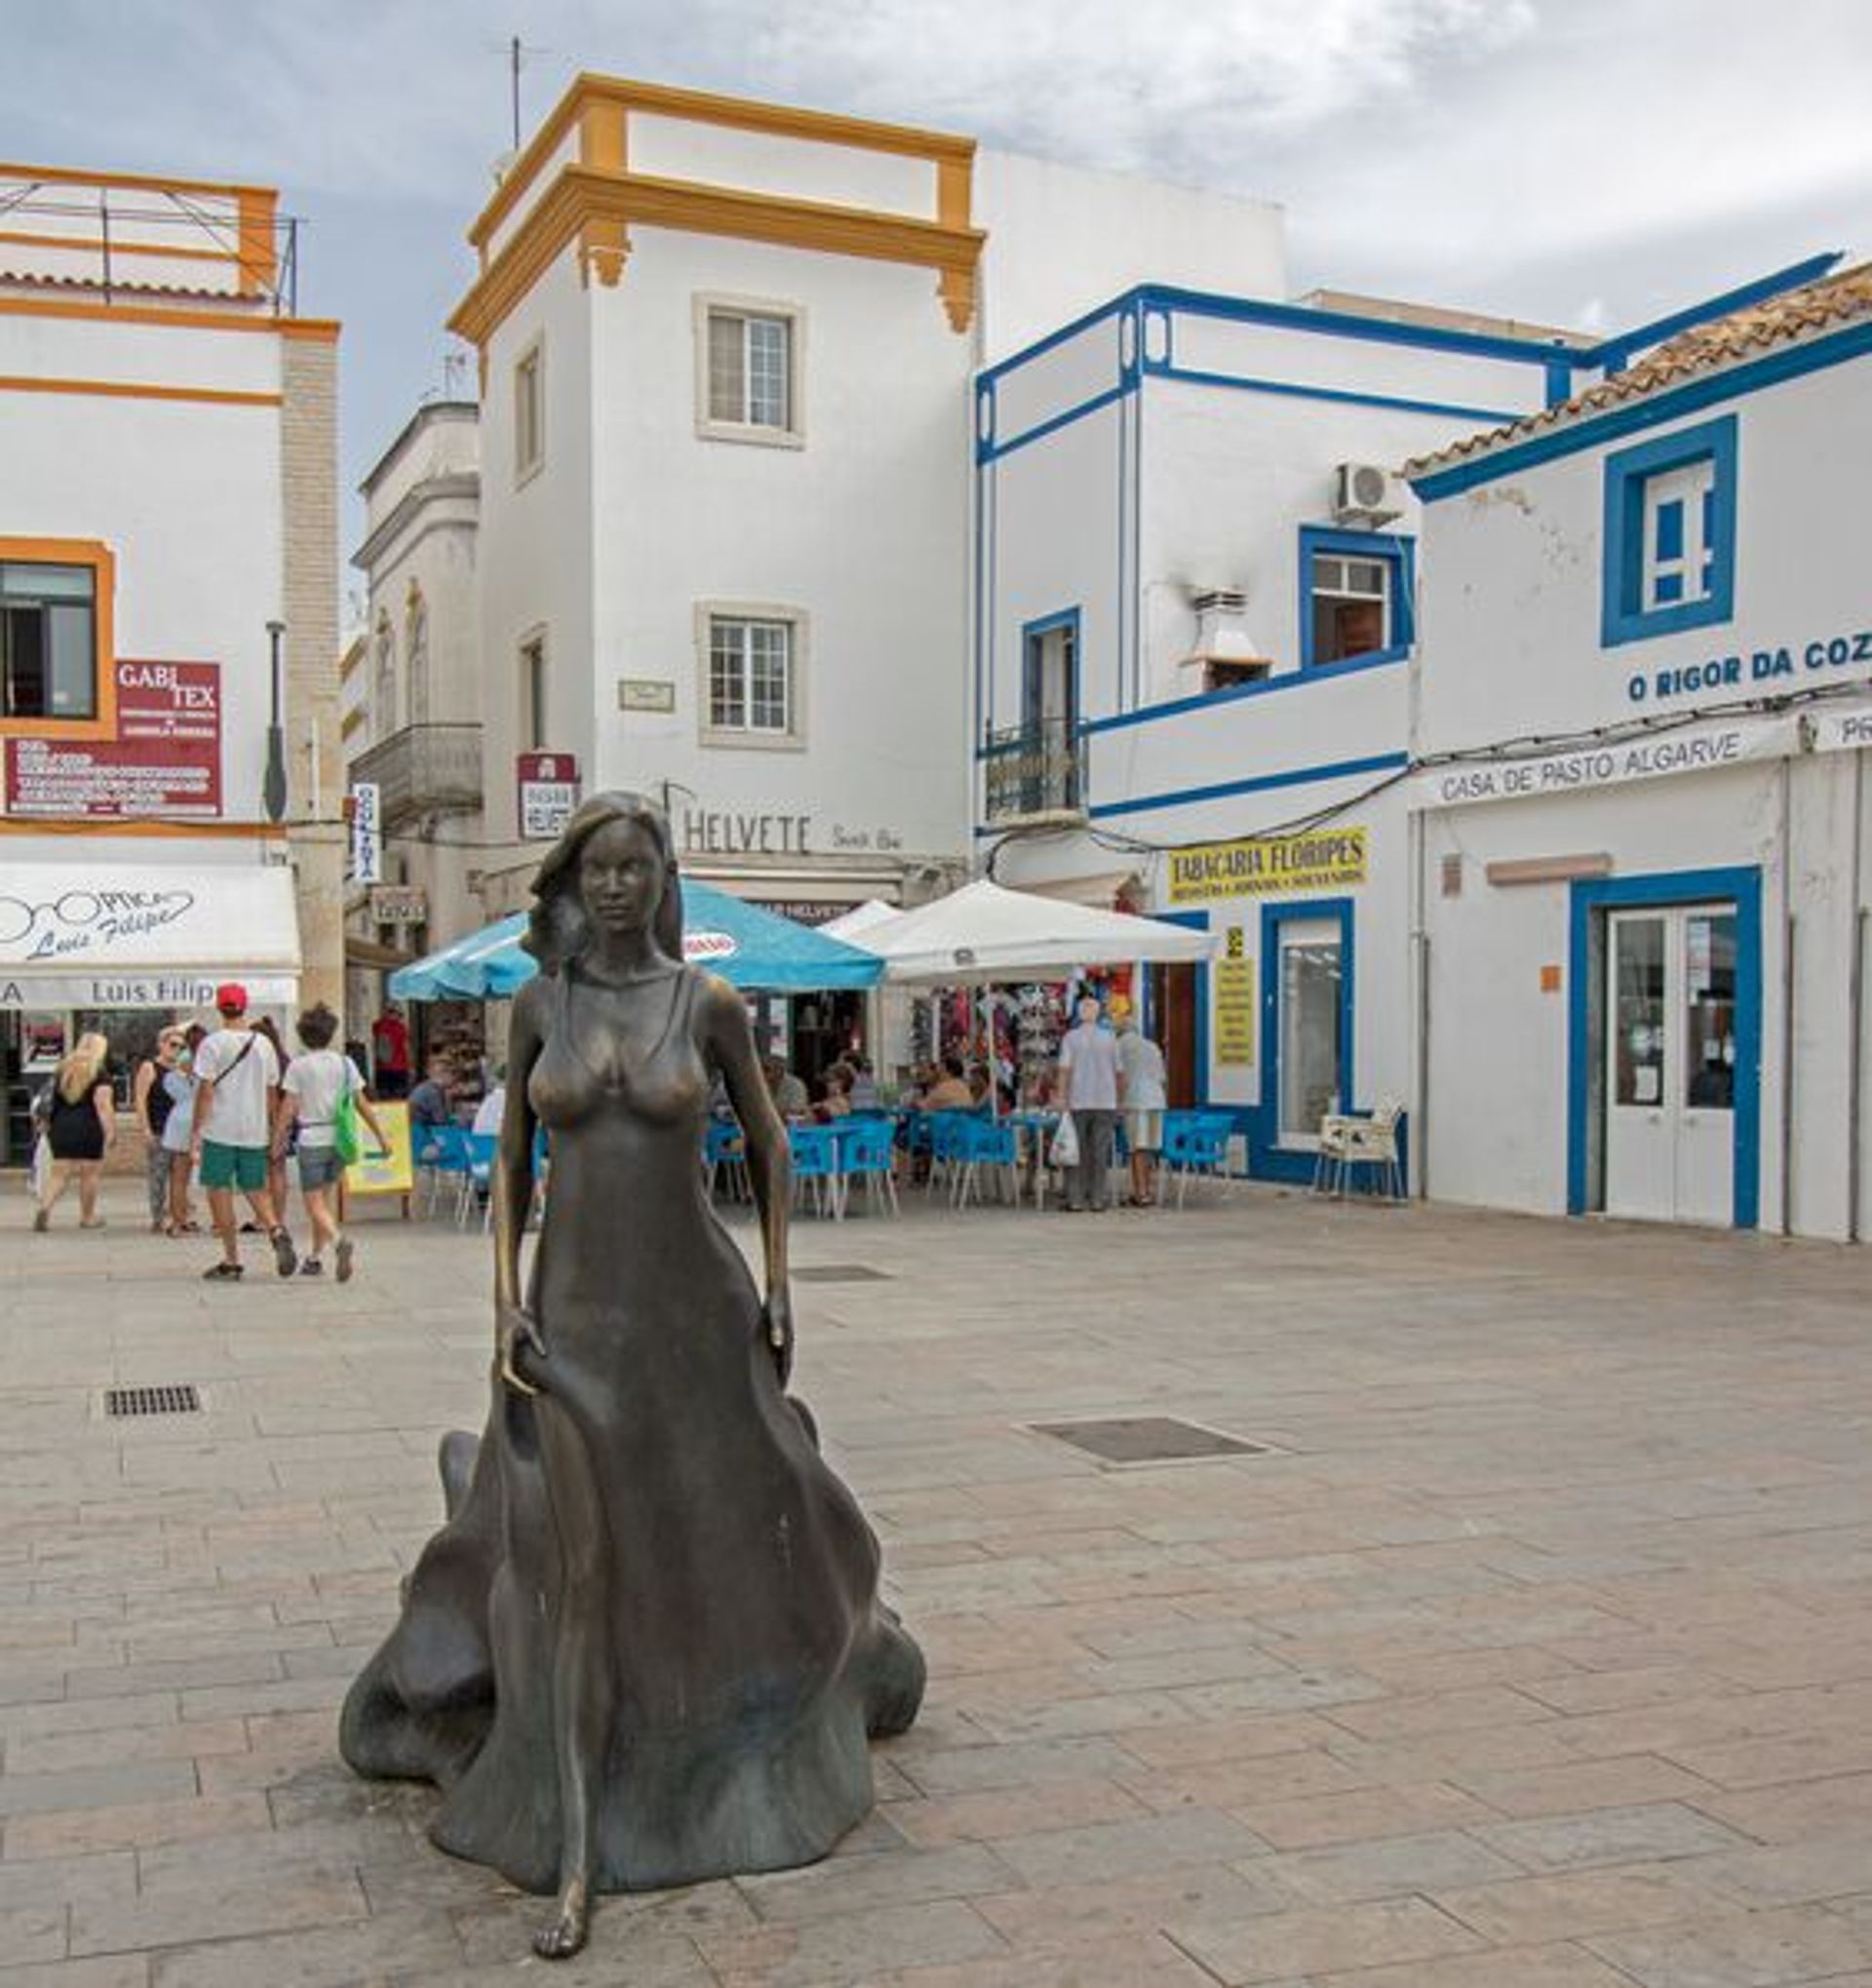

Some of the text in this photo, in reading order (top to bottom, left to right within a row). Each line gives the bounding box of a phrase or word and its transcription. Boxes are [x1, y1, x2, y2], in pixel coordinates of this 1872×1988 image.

[1628, 635, 1872, 701] O RIGOR DA COZ
[174, 686, 216, 708] TEX
[1441, 732, 1741, 801] CASA DE PASTO ALGARVE
[684, 810, 812, 854] HELVETE
[1173, 836, 1364, 882] TABACARIA FLORIPES
[26, 931, 90, 960] Luis
[93, 982, 146, 1001] Luis
[157, 981, 214, 1006] Filip
